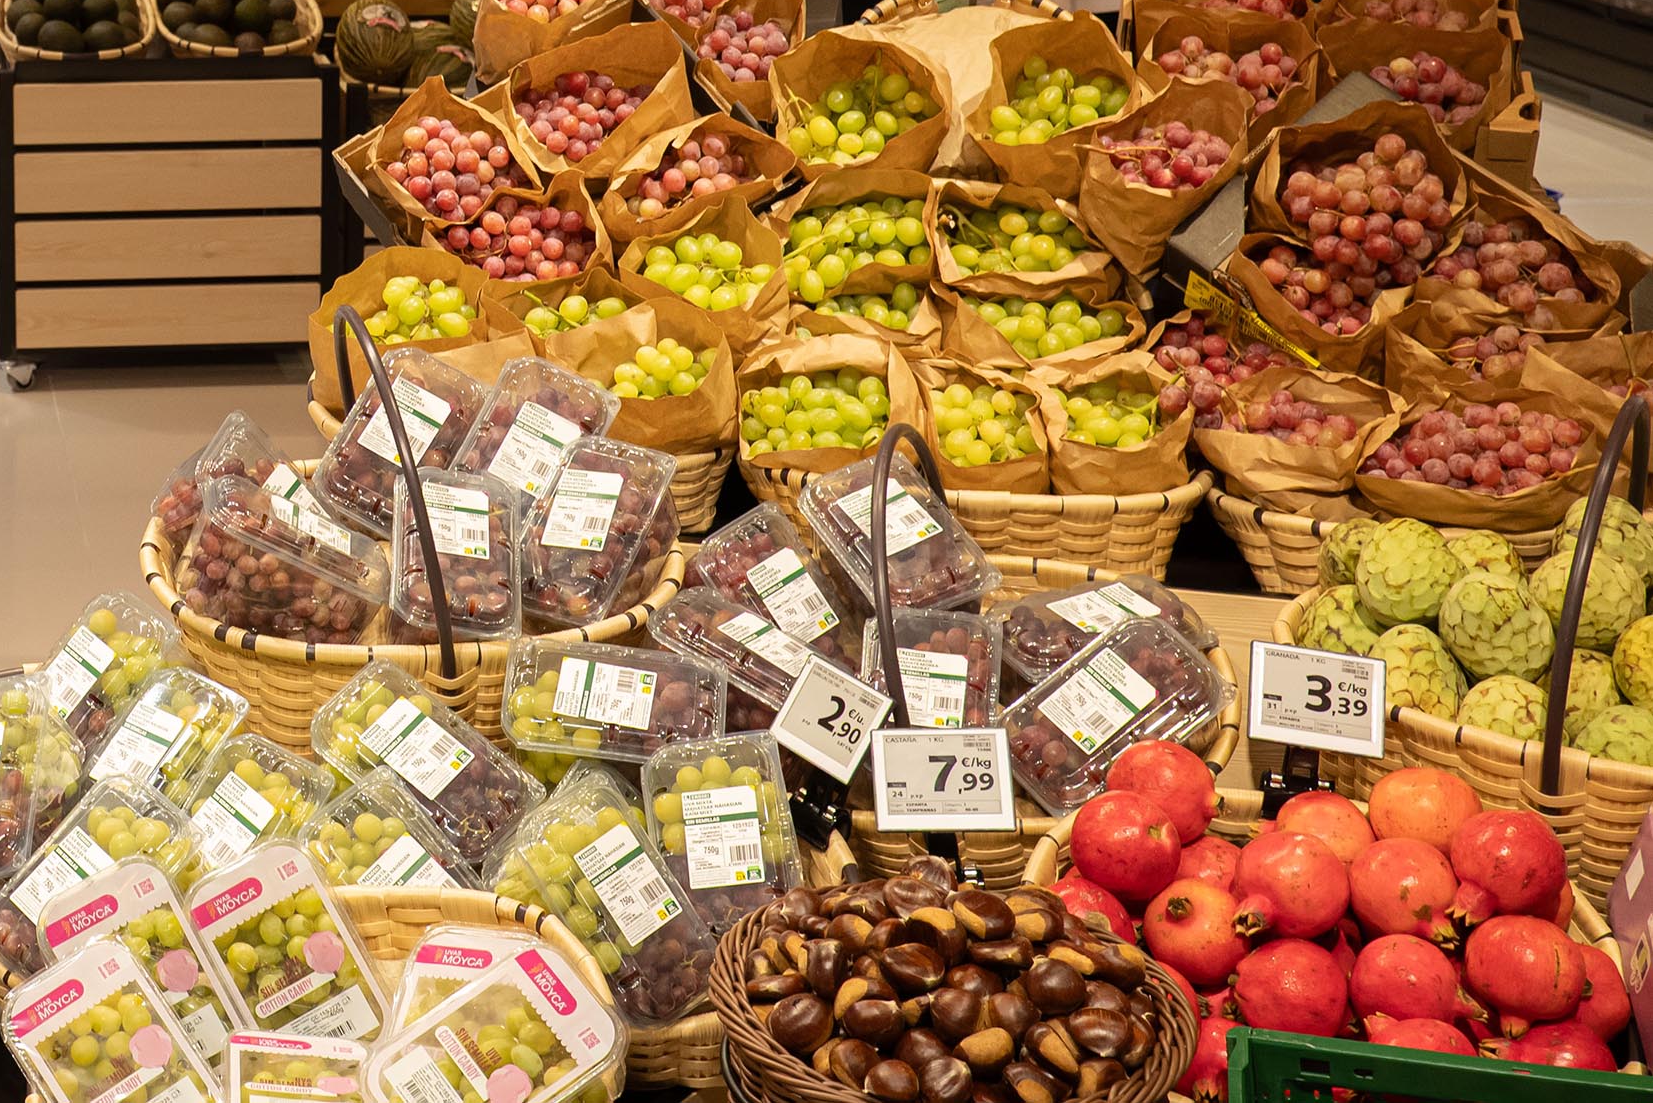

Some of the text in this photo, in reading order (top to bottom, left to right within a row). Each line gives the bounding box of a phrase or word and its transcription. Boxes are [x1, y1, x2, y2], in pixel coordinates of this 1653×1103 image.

[1266, 650, 1300, 660] GRANADA
[1304, 675, 1368, 717] 3,39 €/kg
[1267, 702, 1277, 710] 31
[817, 695, 861, 745] 2,90
[885, 735, 917, 743] CASTAÑA
[928, 755, 995, 795] 7,99 €/kg
[703, 845, 719, 855] 750g
[213, 894, 230, 907] UVAS
[216, 887, 258, 916] MOYCA
[68, 911, 86, 925] UVAS
[71, 904, 114, 933] MOYCA
[441, 954, 485, 967] MOYCA
[542, 969, 557, 986] UVAS
[259, 978, 314, 1016] COTTON CANDY
[533, 974, 567, 1011] MOYCA
[33, 997, 52, 1012] UVAS
[37, 988, 80, 1020] MOYCA
[455, 1027, 472, 1046] SIN
[438, 1029, 463, 1059] COTTON
[458, 1052, 481, 1081] CANDY
[115, 1073, 143, 1097] CANDY
[250, 1083, 313, 1095] COTTON CANDY
